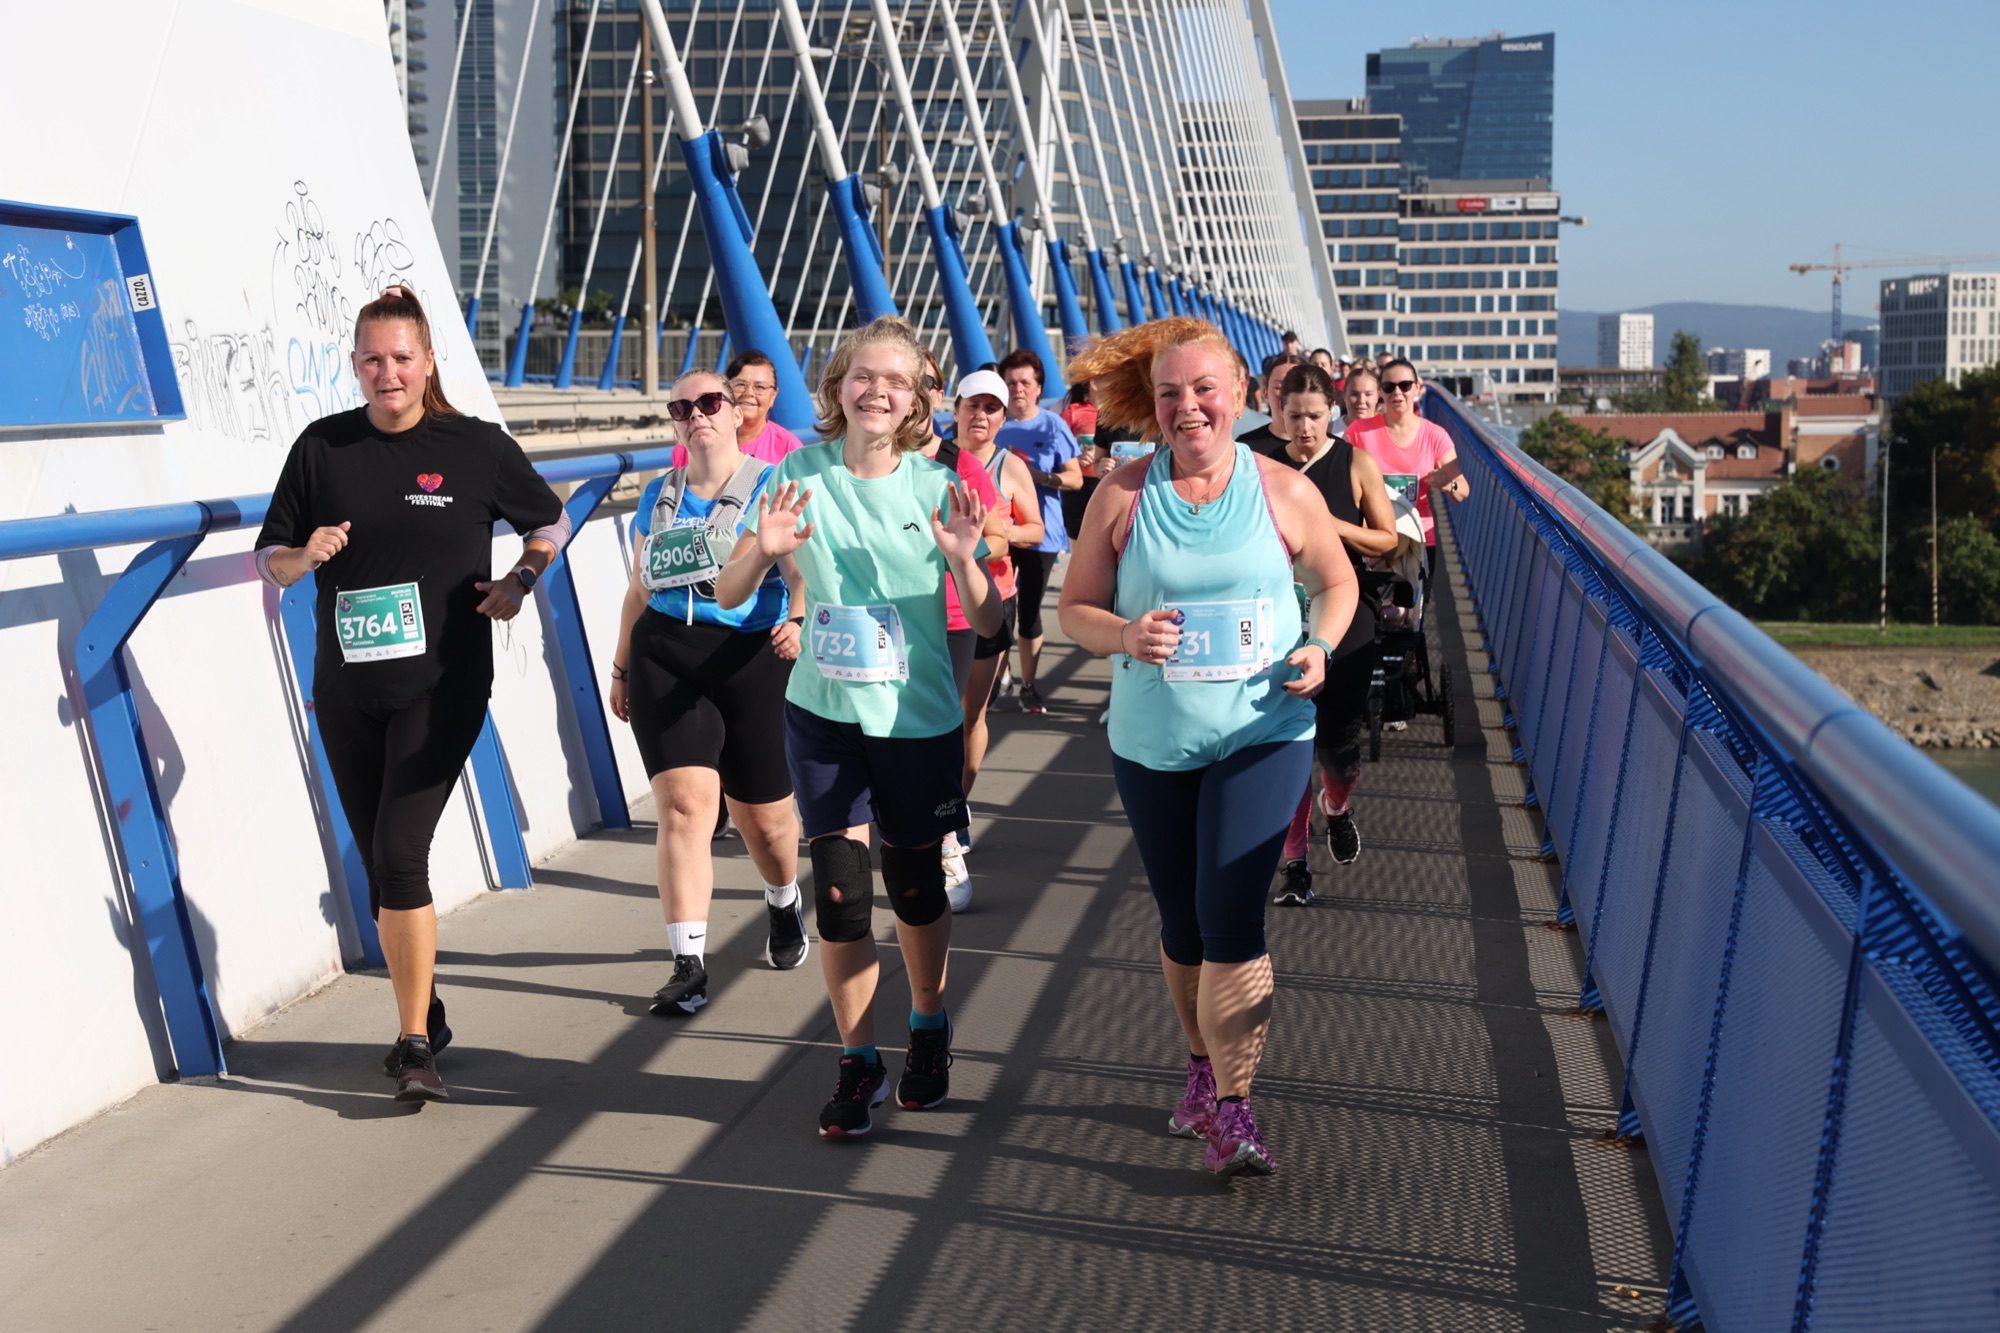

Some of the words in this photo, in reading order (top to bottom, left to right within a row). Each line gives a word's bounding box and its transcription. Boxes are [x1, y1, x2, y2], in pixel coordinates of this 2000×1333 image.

[133, 278, 149, 307] CAZZO.
[404, 494, 453, 503] LOVESTREAM
[411, 499, 446, 508] FESTIVAL
[652, 543, 695, 571] 2906
[340, 612, 399, 640] 3764
[814, 629, 856, 657] 732
